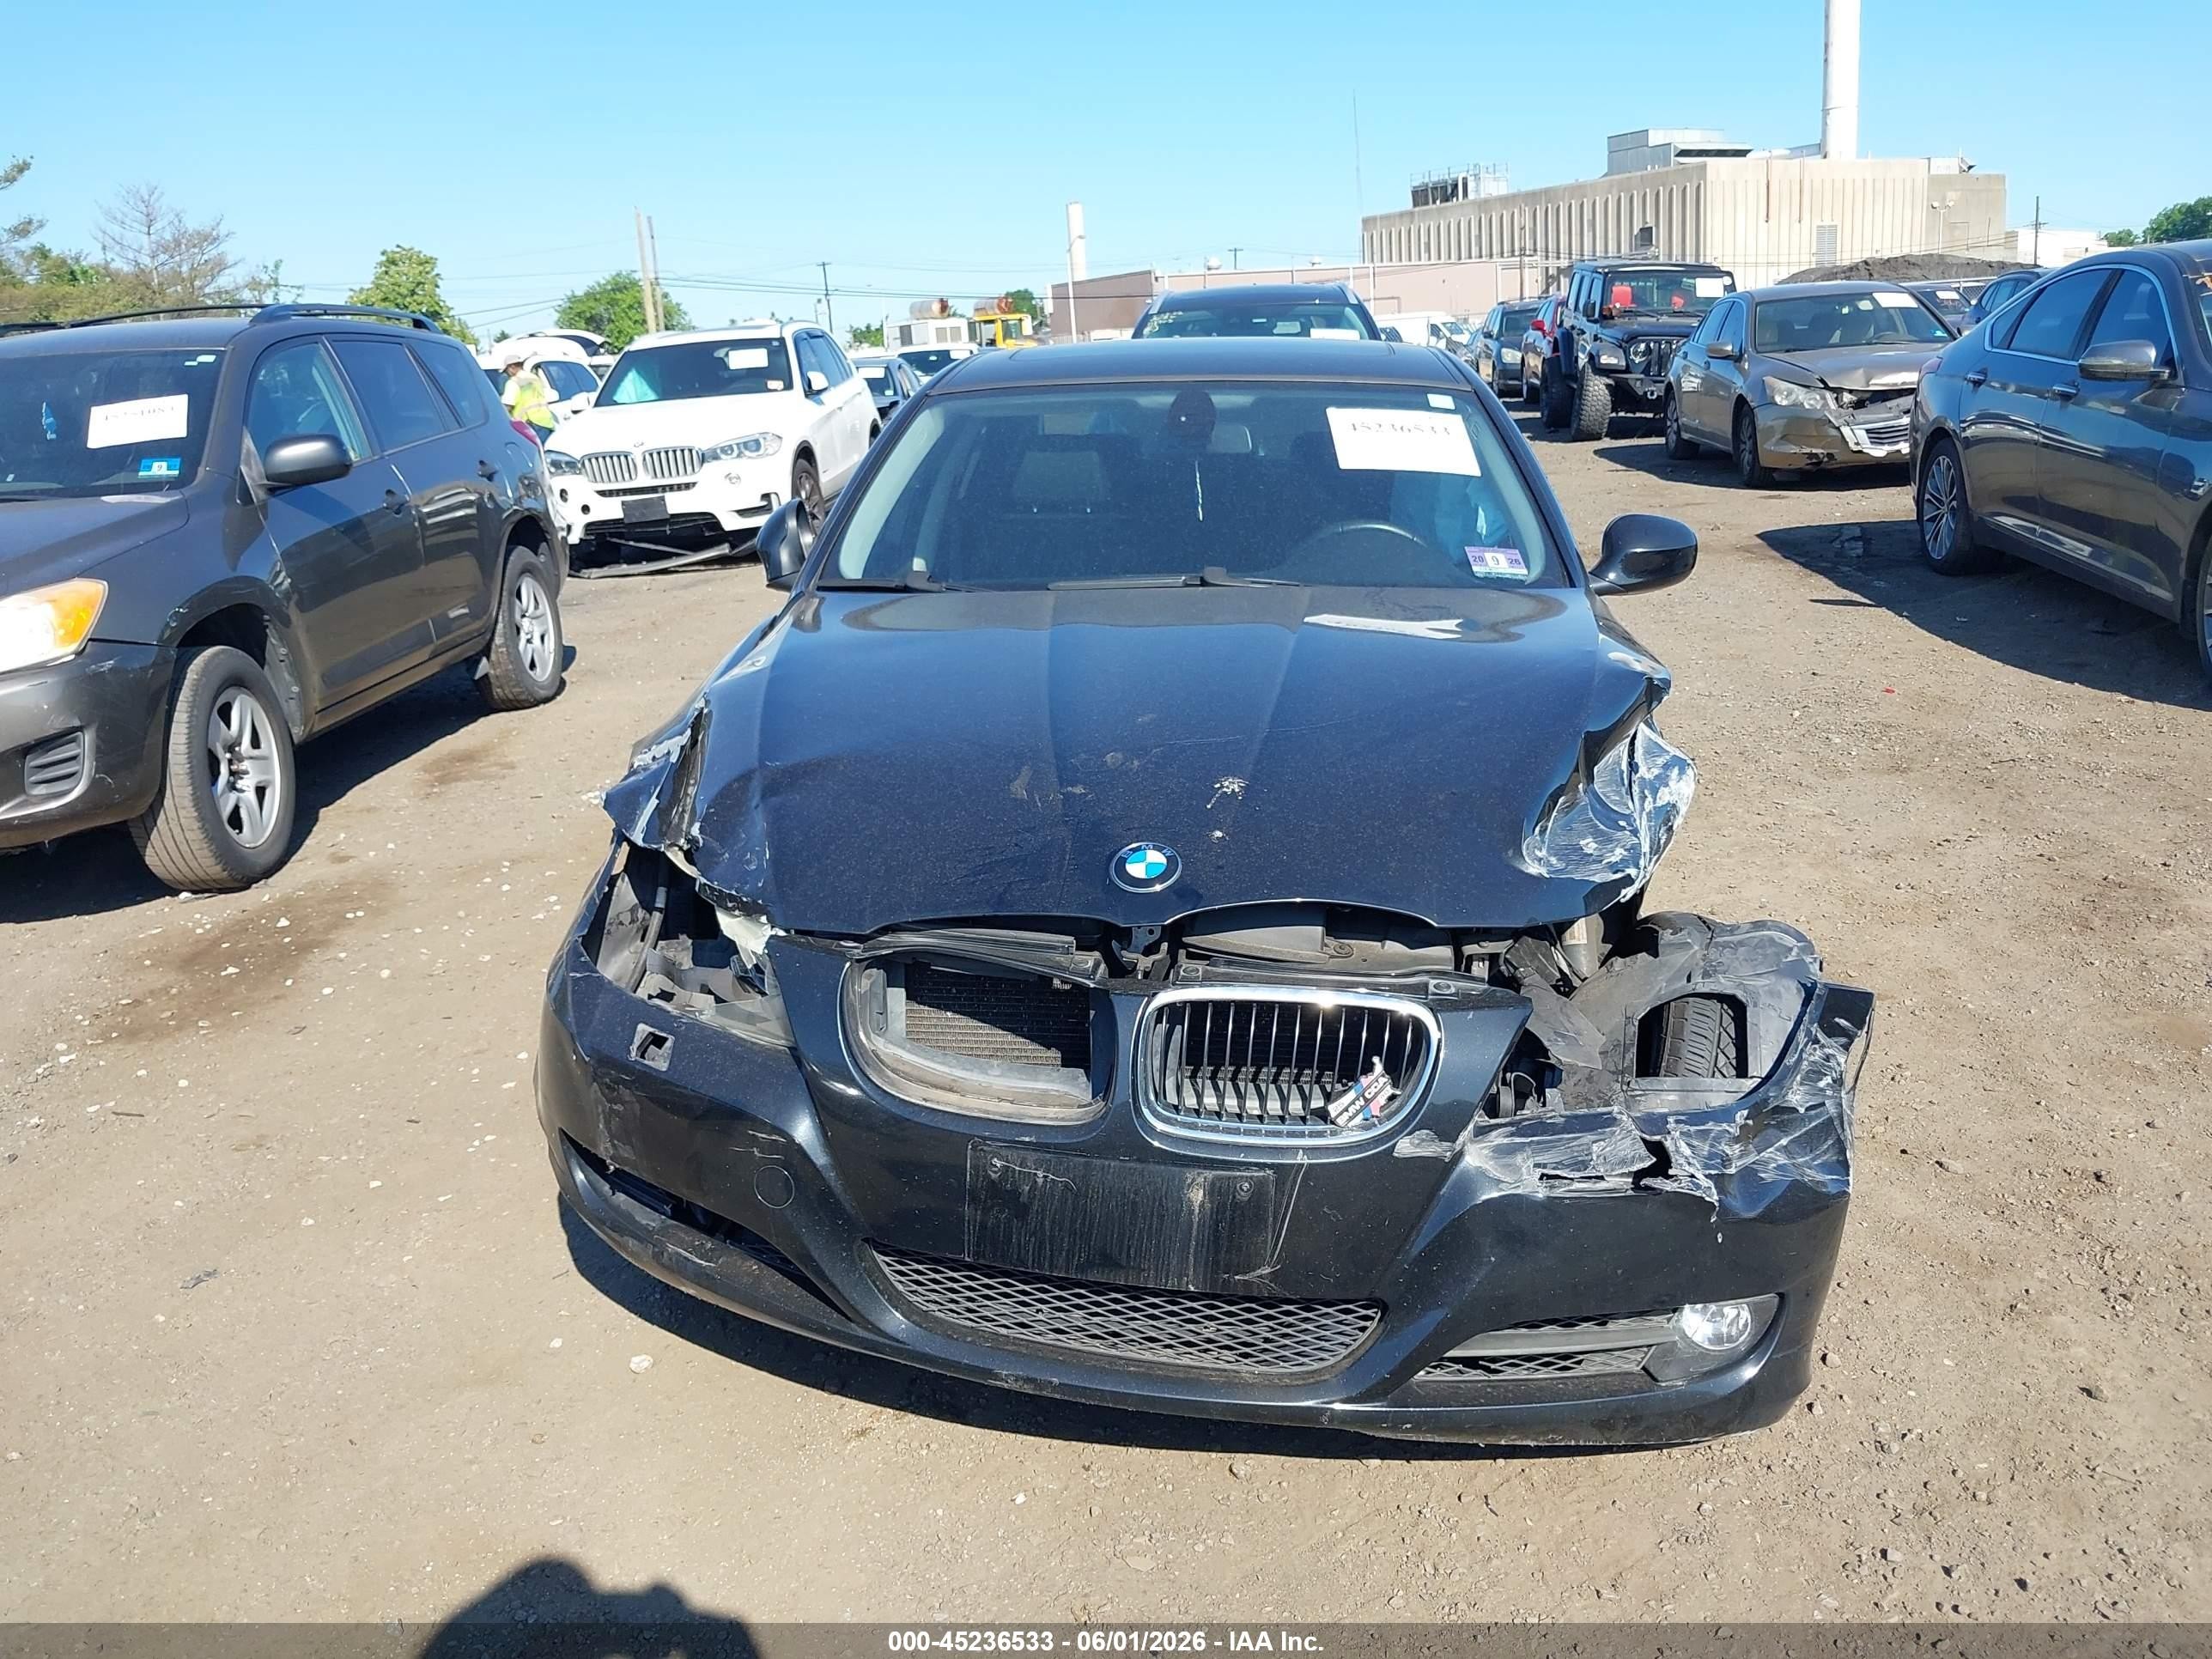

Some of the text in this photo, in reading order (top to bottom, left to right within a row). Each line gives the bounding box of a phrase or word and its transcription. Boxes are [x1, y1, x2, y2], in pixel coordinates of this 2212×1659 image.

[1471, 555, 1485, 563] 20
[1491, 556, 1499, 566] 9
[1121, 844, 1175, 859] BMW
[1335, 1097, 1365, 1127] BMW
[1364, 1076, 1389, 1099] CCA
